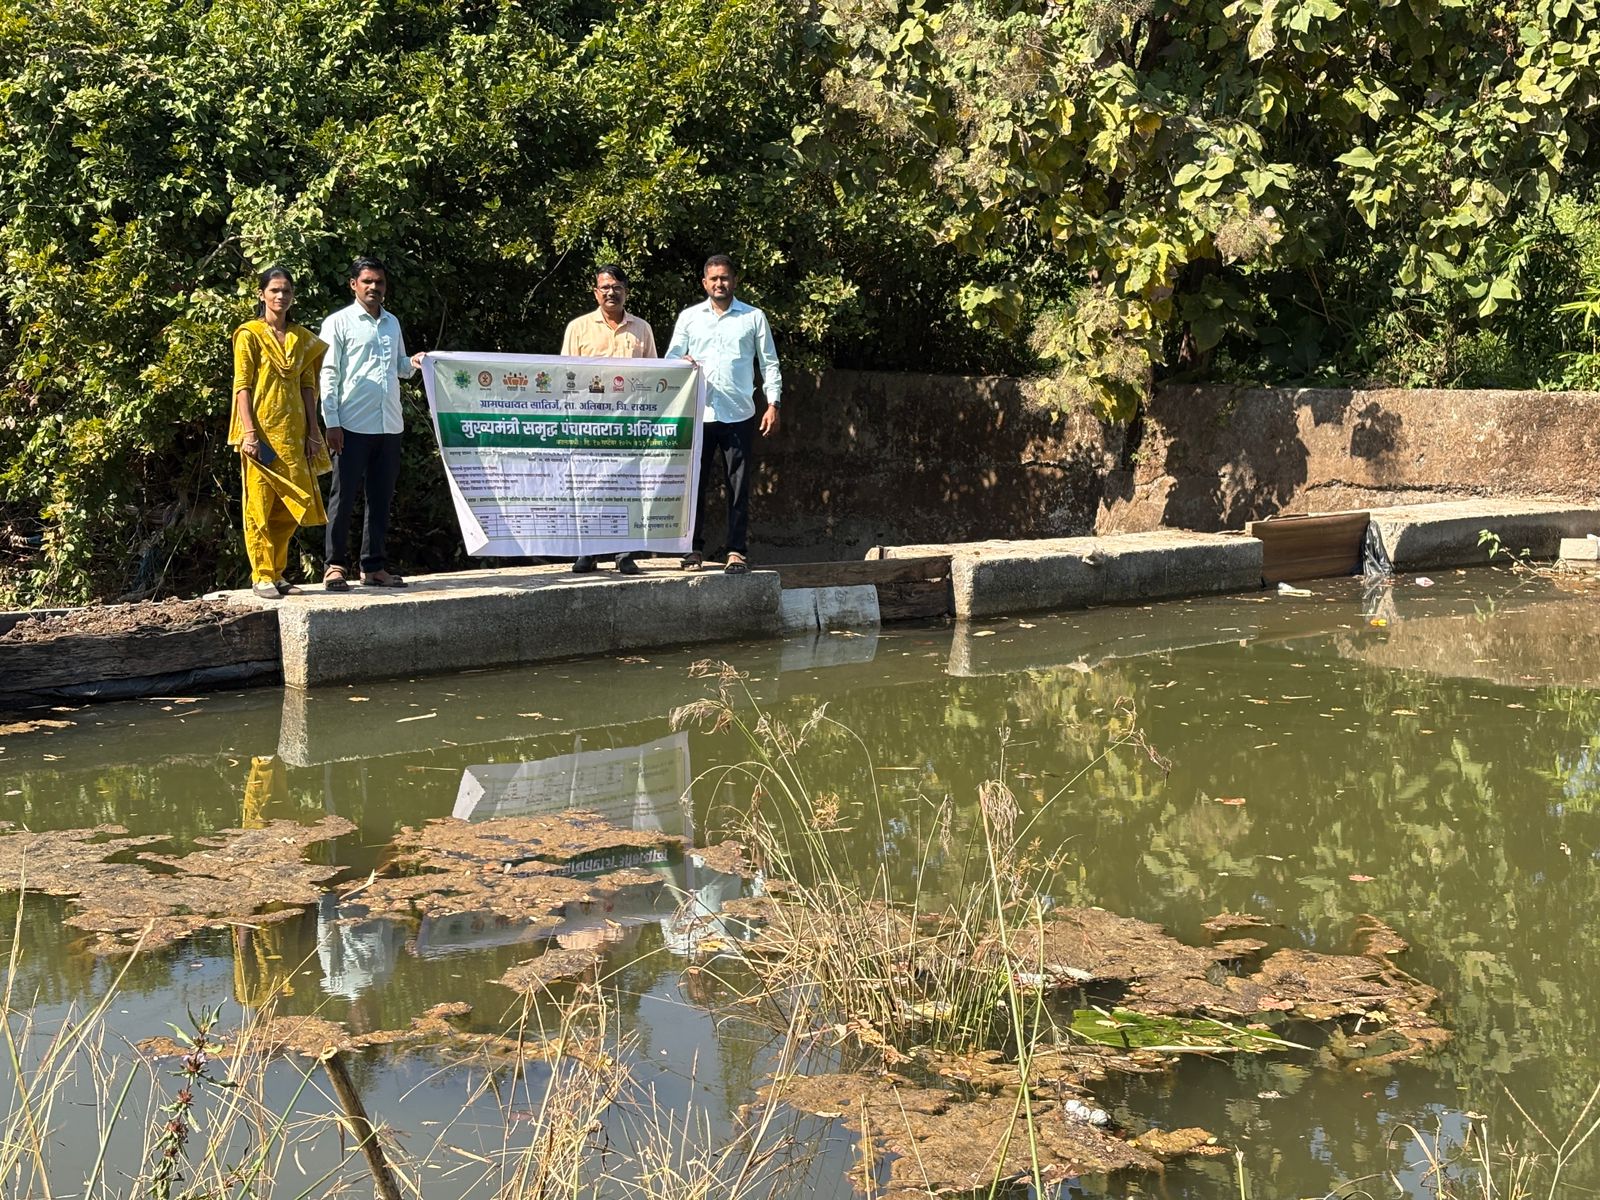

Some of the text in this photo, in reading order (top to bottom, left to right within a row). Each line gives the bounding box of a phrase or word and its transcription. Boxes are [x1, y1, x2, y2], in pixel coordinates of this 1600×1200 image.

[480, 398, 528, 409] ग्रामपंचायत
[579, 400, 614, 411] अलिबाग,
[631, 403, 658, 412] रायगड
[460, 417, 678, 441] मुख्यमंत्री समृद्ध पंचायतराज अभियान
